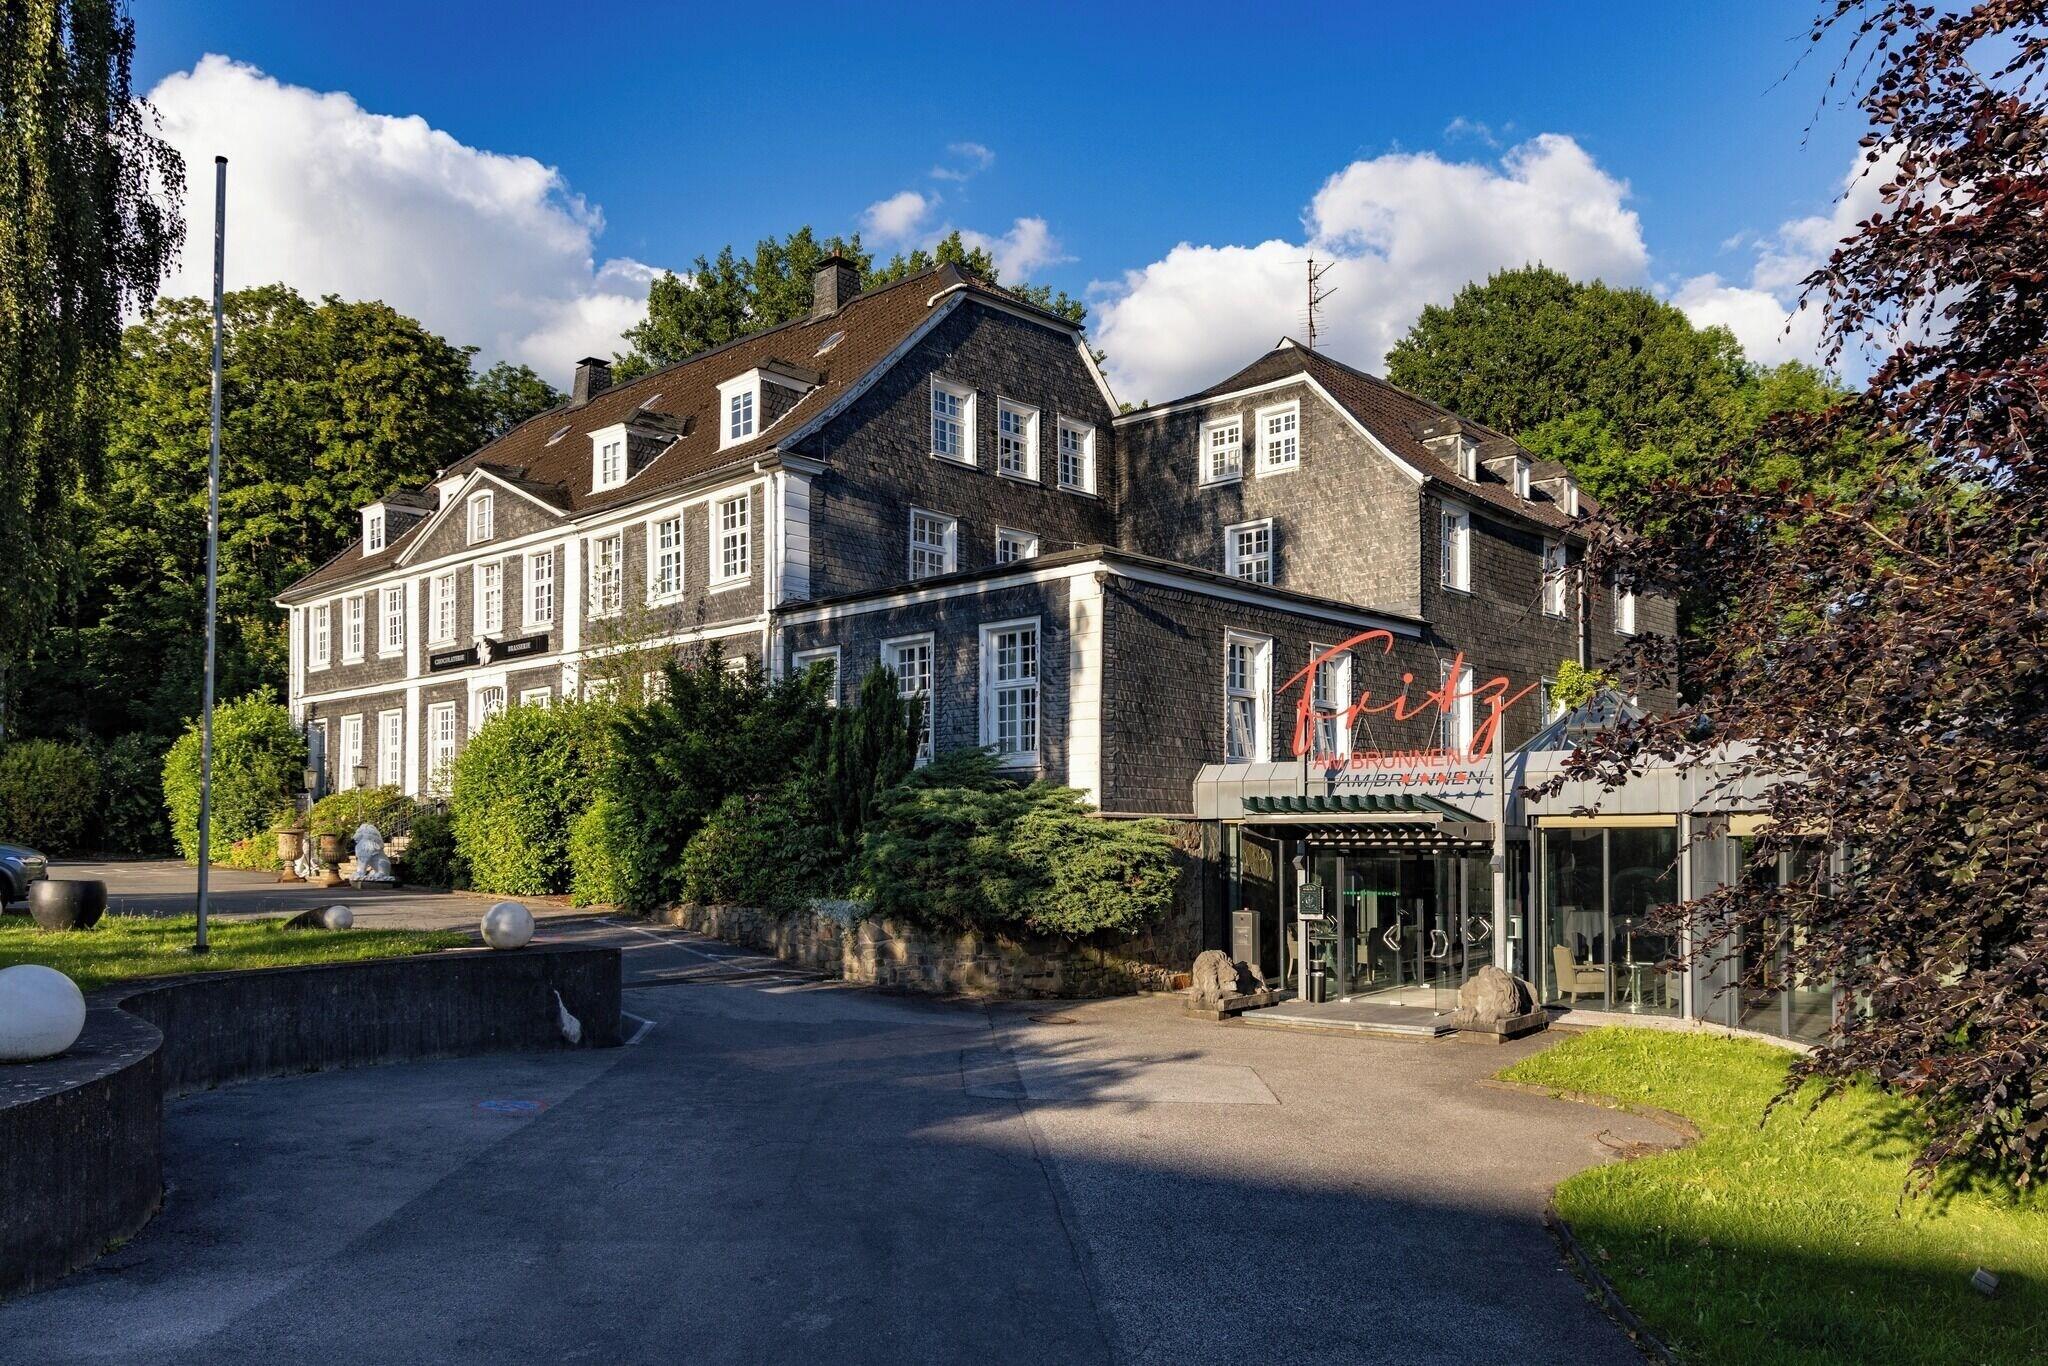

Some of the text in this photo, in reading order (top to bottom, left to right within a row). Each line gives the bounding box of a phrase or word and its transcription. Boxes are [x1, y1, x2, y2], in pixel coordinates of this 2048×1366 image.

[1276, 629, 1539, 763] Fritz
[1313, 747, 1461, 770] AM BRUNNEN
